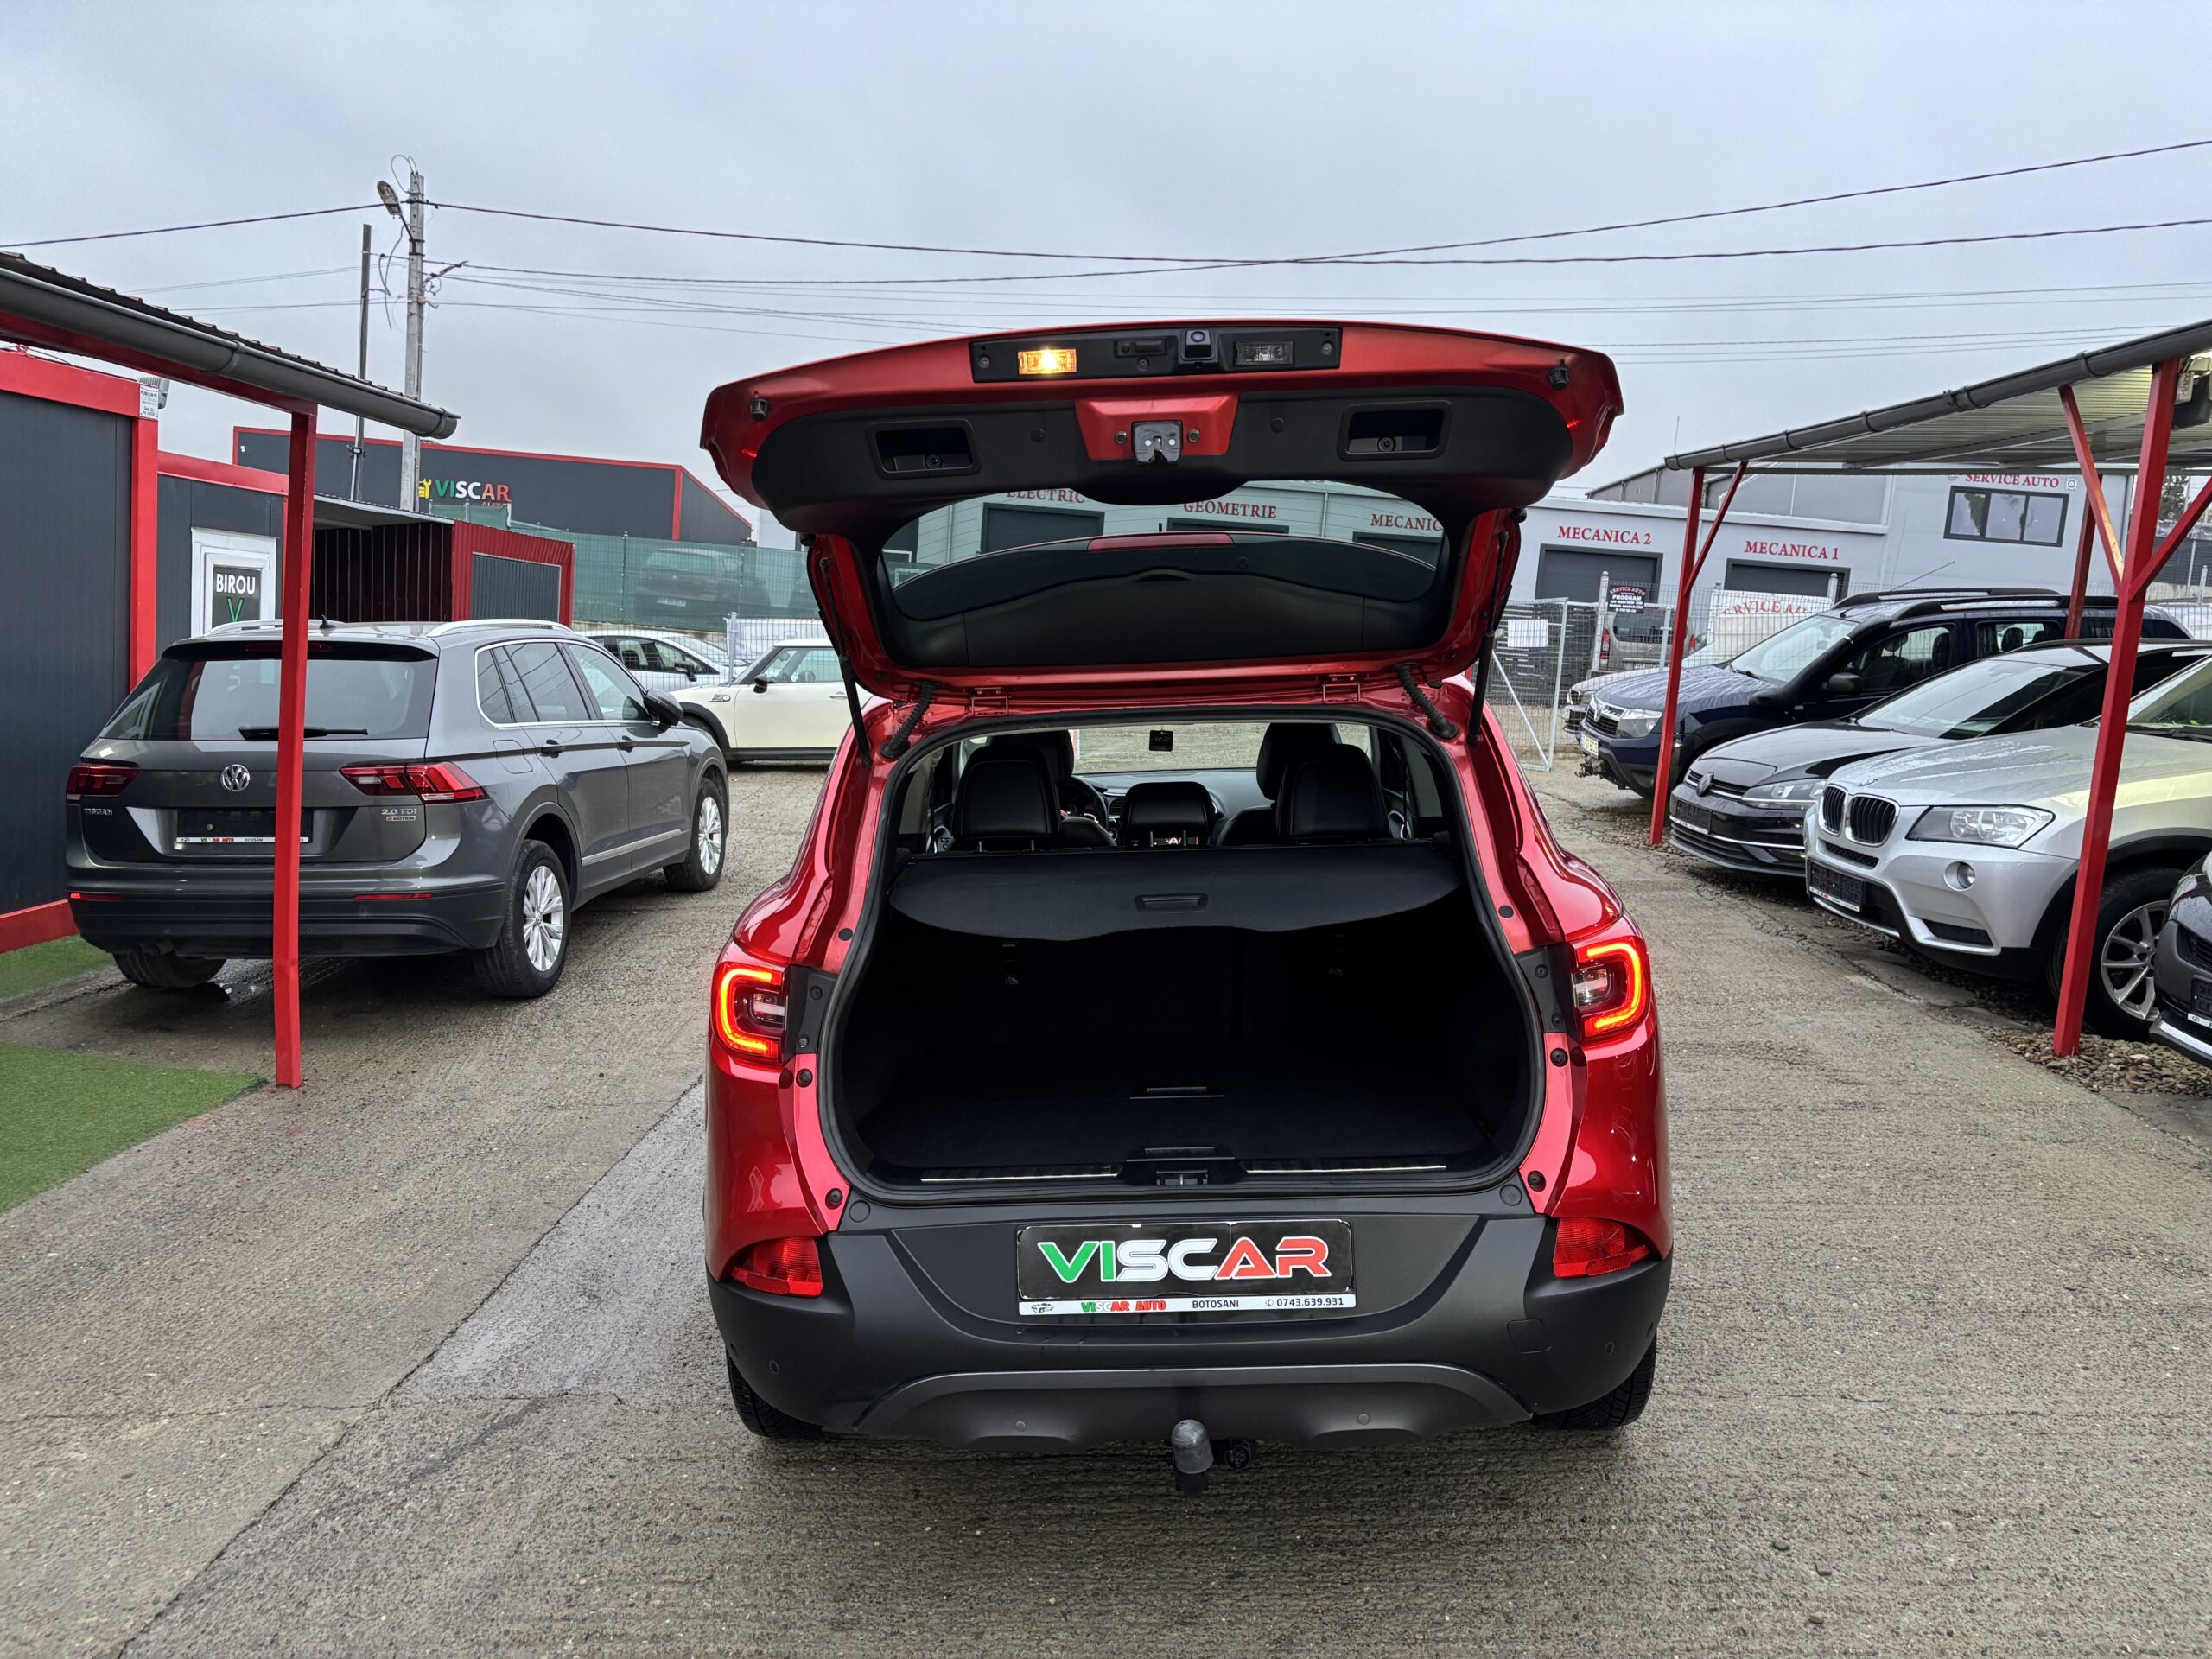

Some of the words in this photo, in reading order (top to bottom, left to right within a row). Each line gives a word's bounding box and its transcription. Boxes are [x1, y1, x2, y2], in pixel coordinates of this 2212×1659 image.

[435, 479, 510, 502] VISCAR
[1965, 474, 2020, 486] SERVICE
[2022, 476, 2059, 488] AUTO
[1183, 501, 1277, 518] GEOMETRIE
[1557, 525, 1640, 544] MECANICA
[1643, 532, 1652, 545] 2
[1744, 540, 1828, 560] MECANICA
[1832, 547, 1839, 560] 1
[216, 573, 256, 595] BIROU
[1038, 1237, 1332, 1283] VISCAR
[1081, 1301, 1130, 1313] VISCAR
[1135, 1300, 1166, 1311] AUTO
[1192, 1300, 1240, 1309] BOTOSANI
[1276, 1297, 1344, 1307] 0743.639.931
